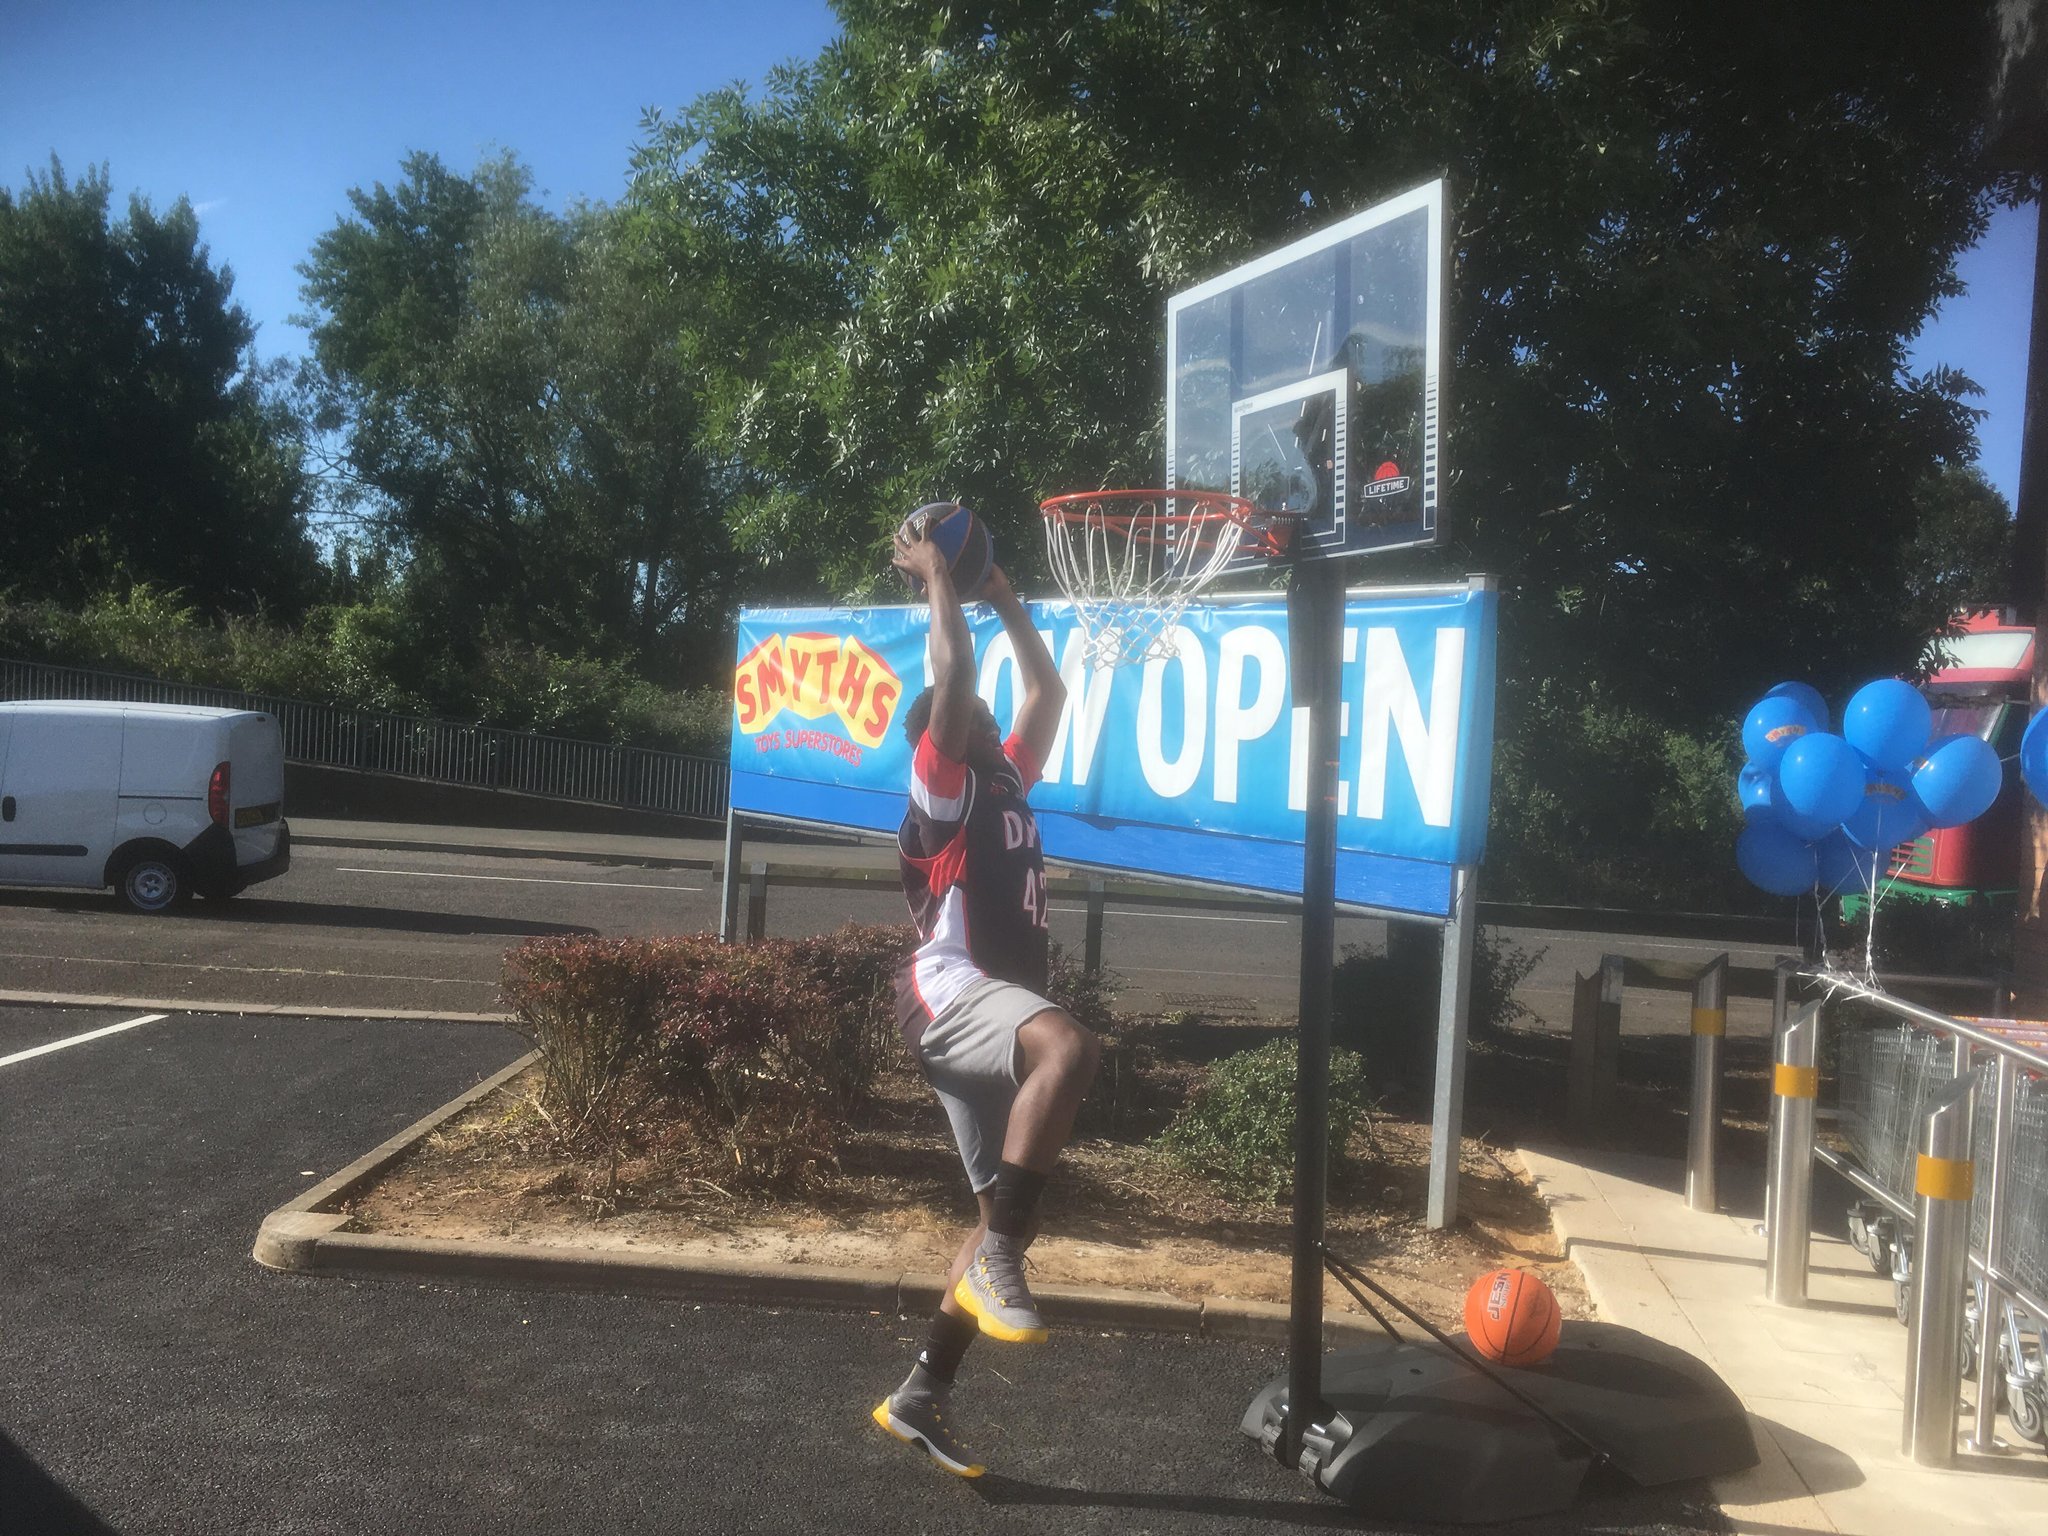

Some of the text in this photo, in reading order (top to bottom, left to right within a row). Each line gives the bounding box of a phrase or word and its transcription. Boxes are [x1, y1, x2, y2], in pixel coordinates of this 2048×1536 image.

[1369, 479, 1405, 494] LIFETIME
[736, 645, 897, 738] SMYTHS
[924, 627, 1122, 786] OW
[754, 729, 864, 768] TOYS SUPERSTORES
